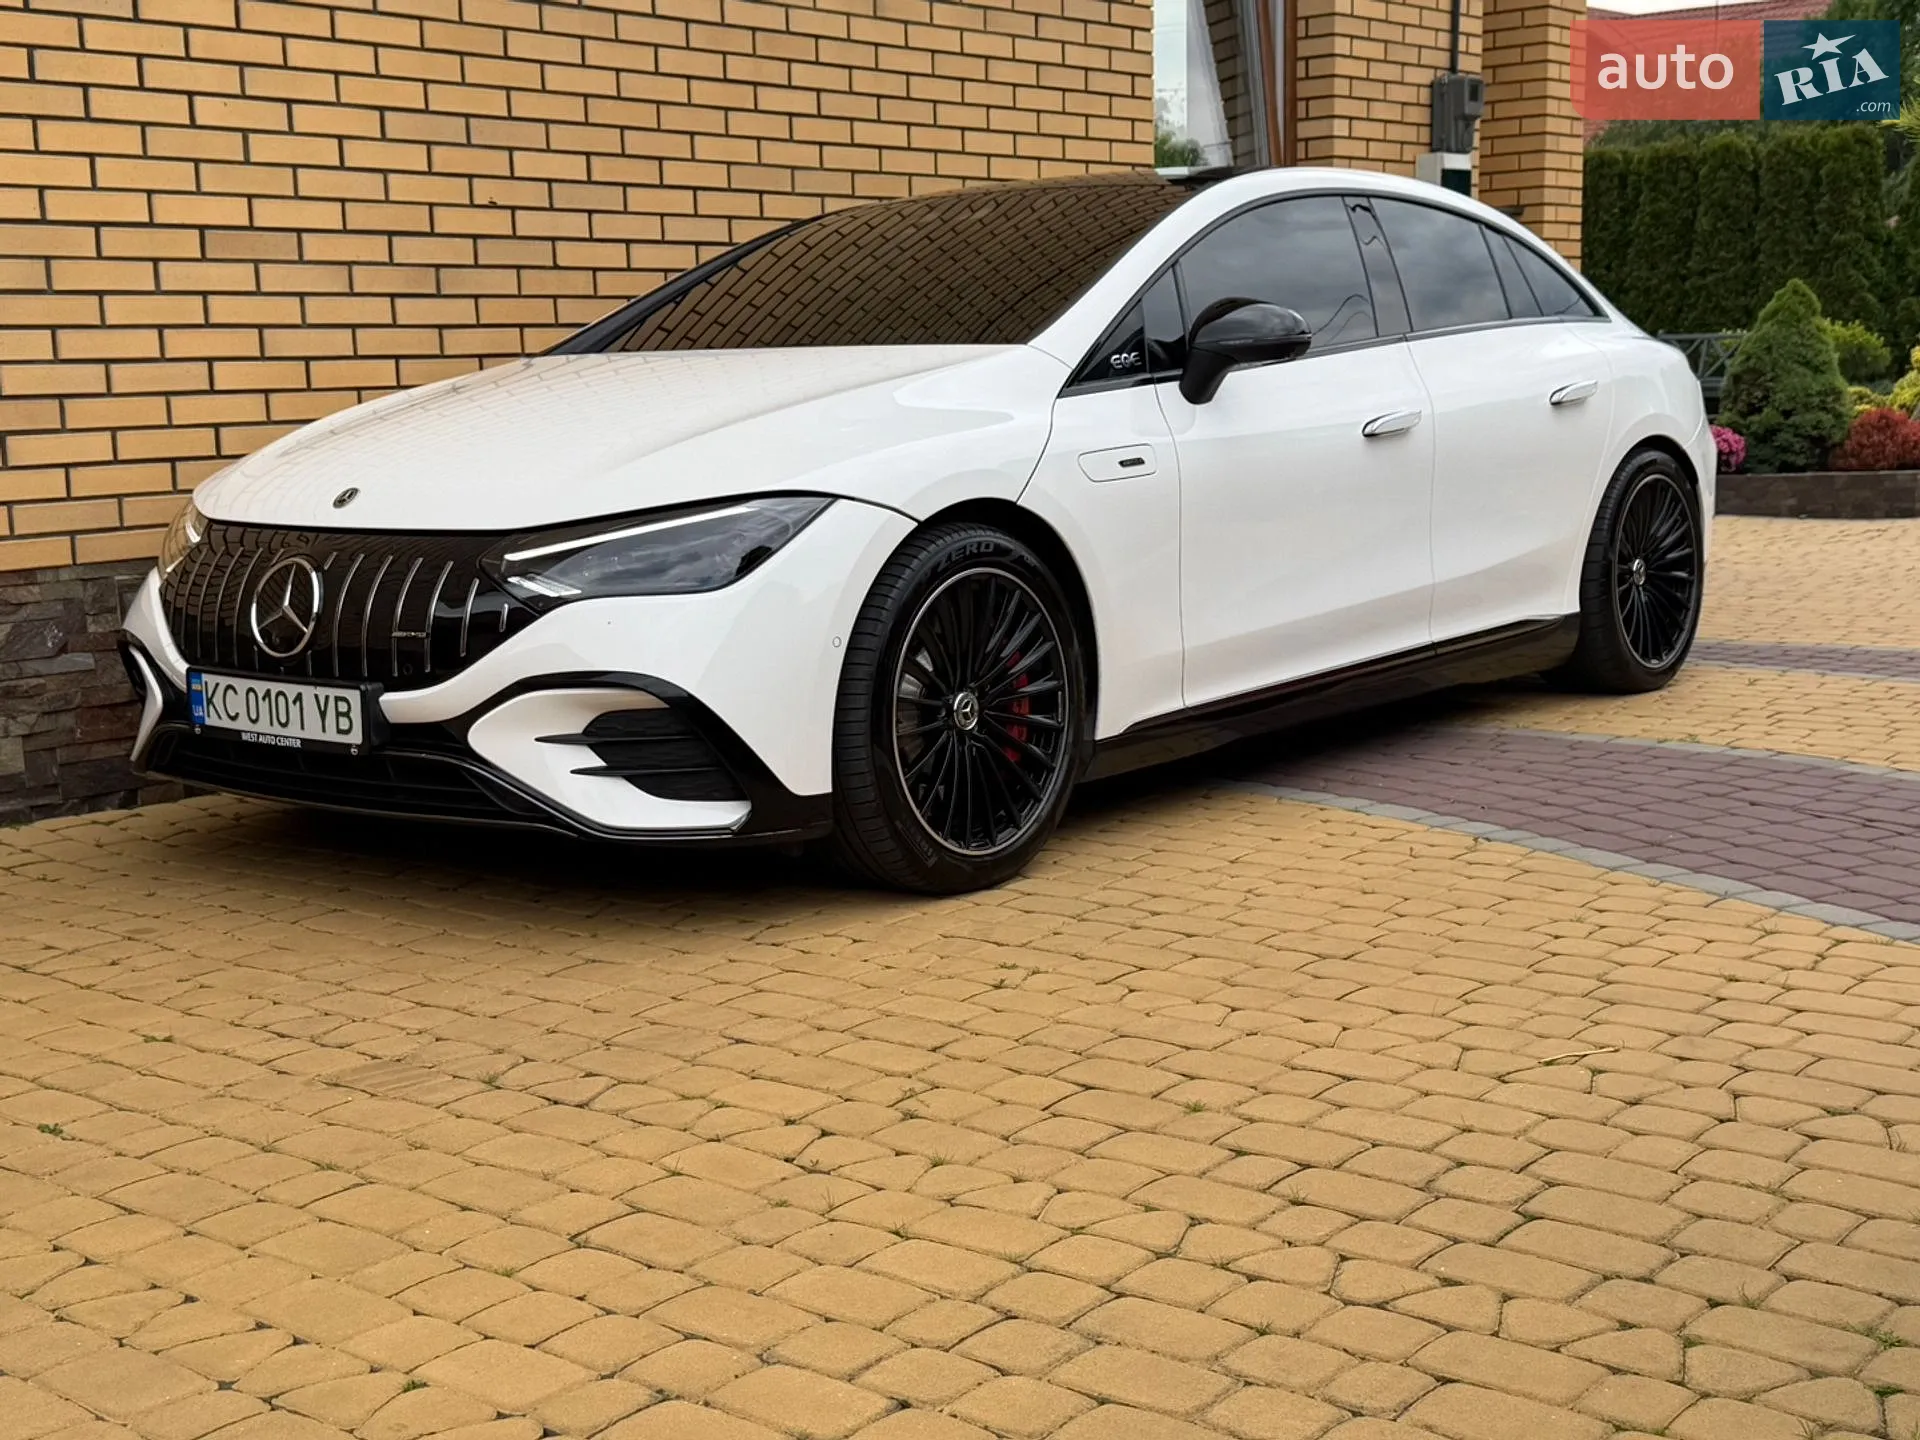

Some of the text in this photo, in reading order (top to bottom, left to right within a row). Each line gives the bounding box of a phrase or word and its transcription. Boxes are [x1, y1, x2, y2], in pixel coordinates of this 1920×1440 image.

[204, 680, 354, 735] KC 0101 YB
[241, 731, 302, 748] WEST AUTO CENTER
